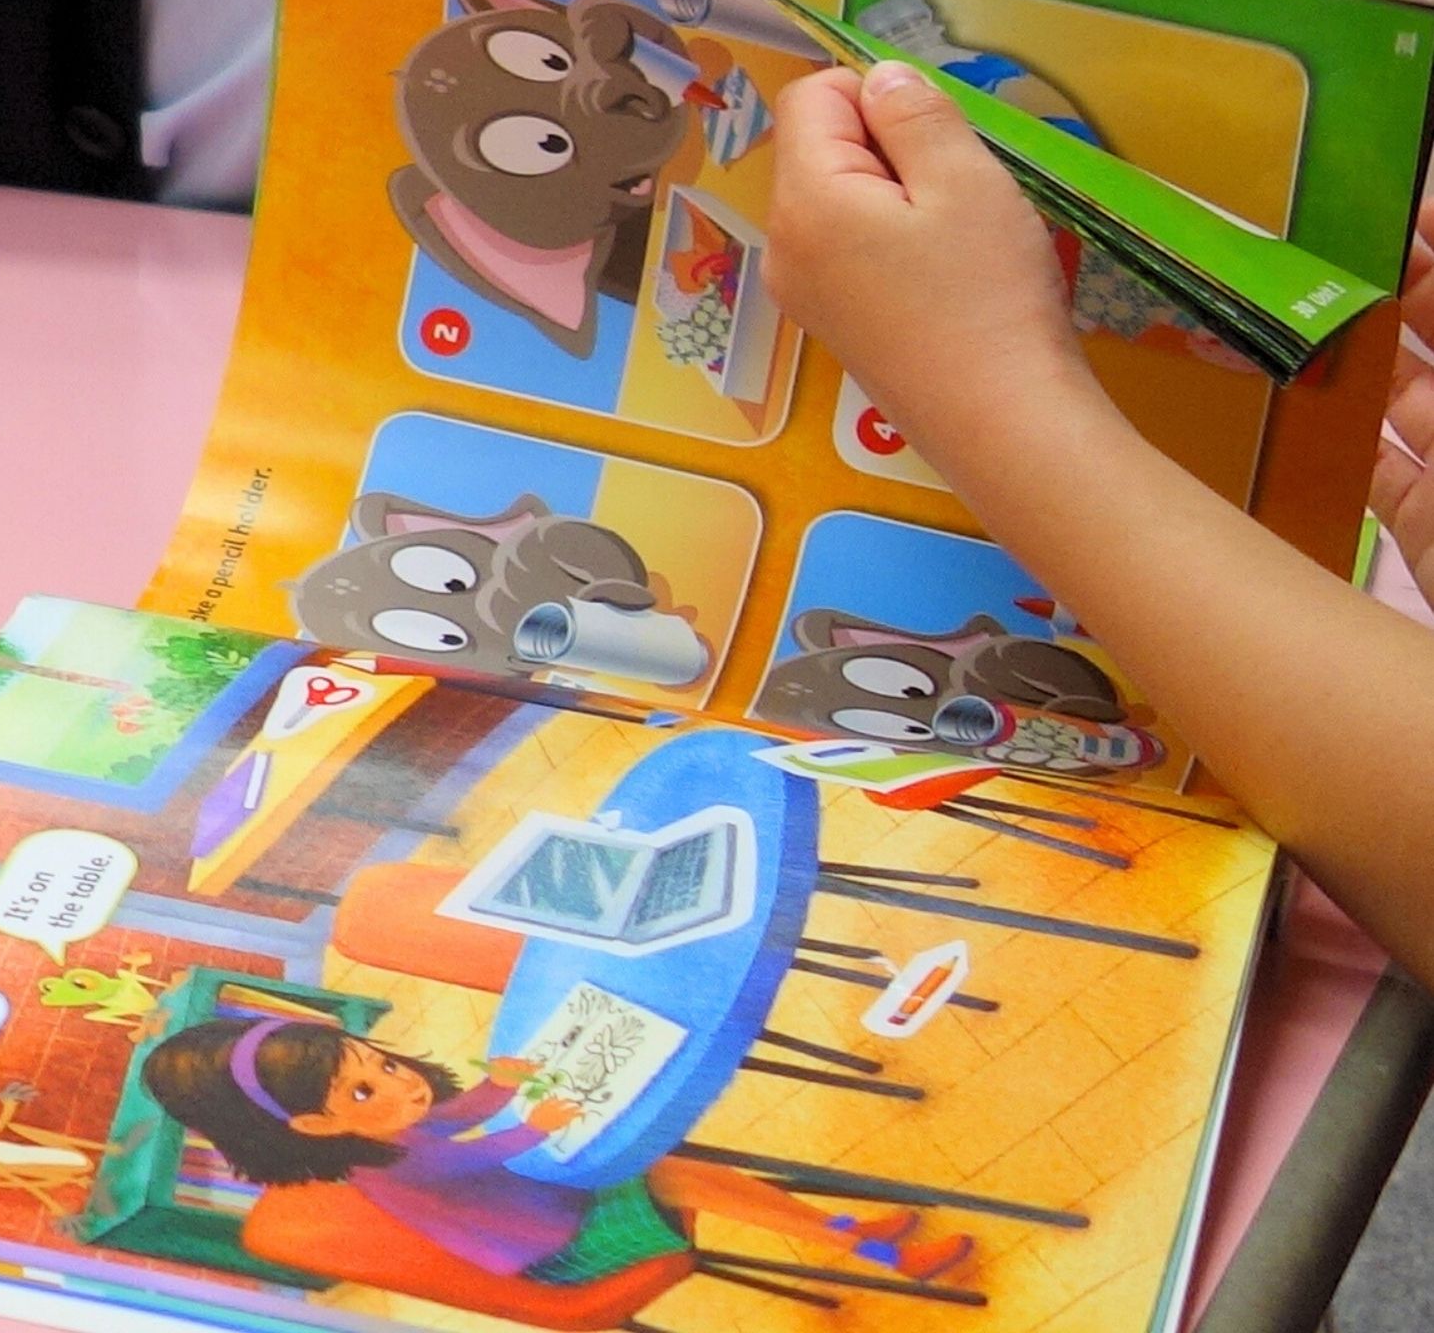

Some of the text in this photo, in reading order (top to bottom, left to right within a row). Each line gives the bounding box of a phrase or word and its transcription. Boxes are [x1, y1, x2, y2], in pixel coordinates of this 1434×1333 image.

[434, 324, 459, 343] 2
[187, 466, 274, 623] ake a pencil holder.
[3, 871, 55, 923] It's on
[48, 853, 114, 931] the table.
